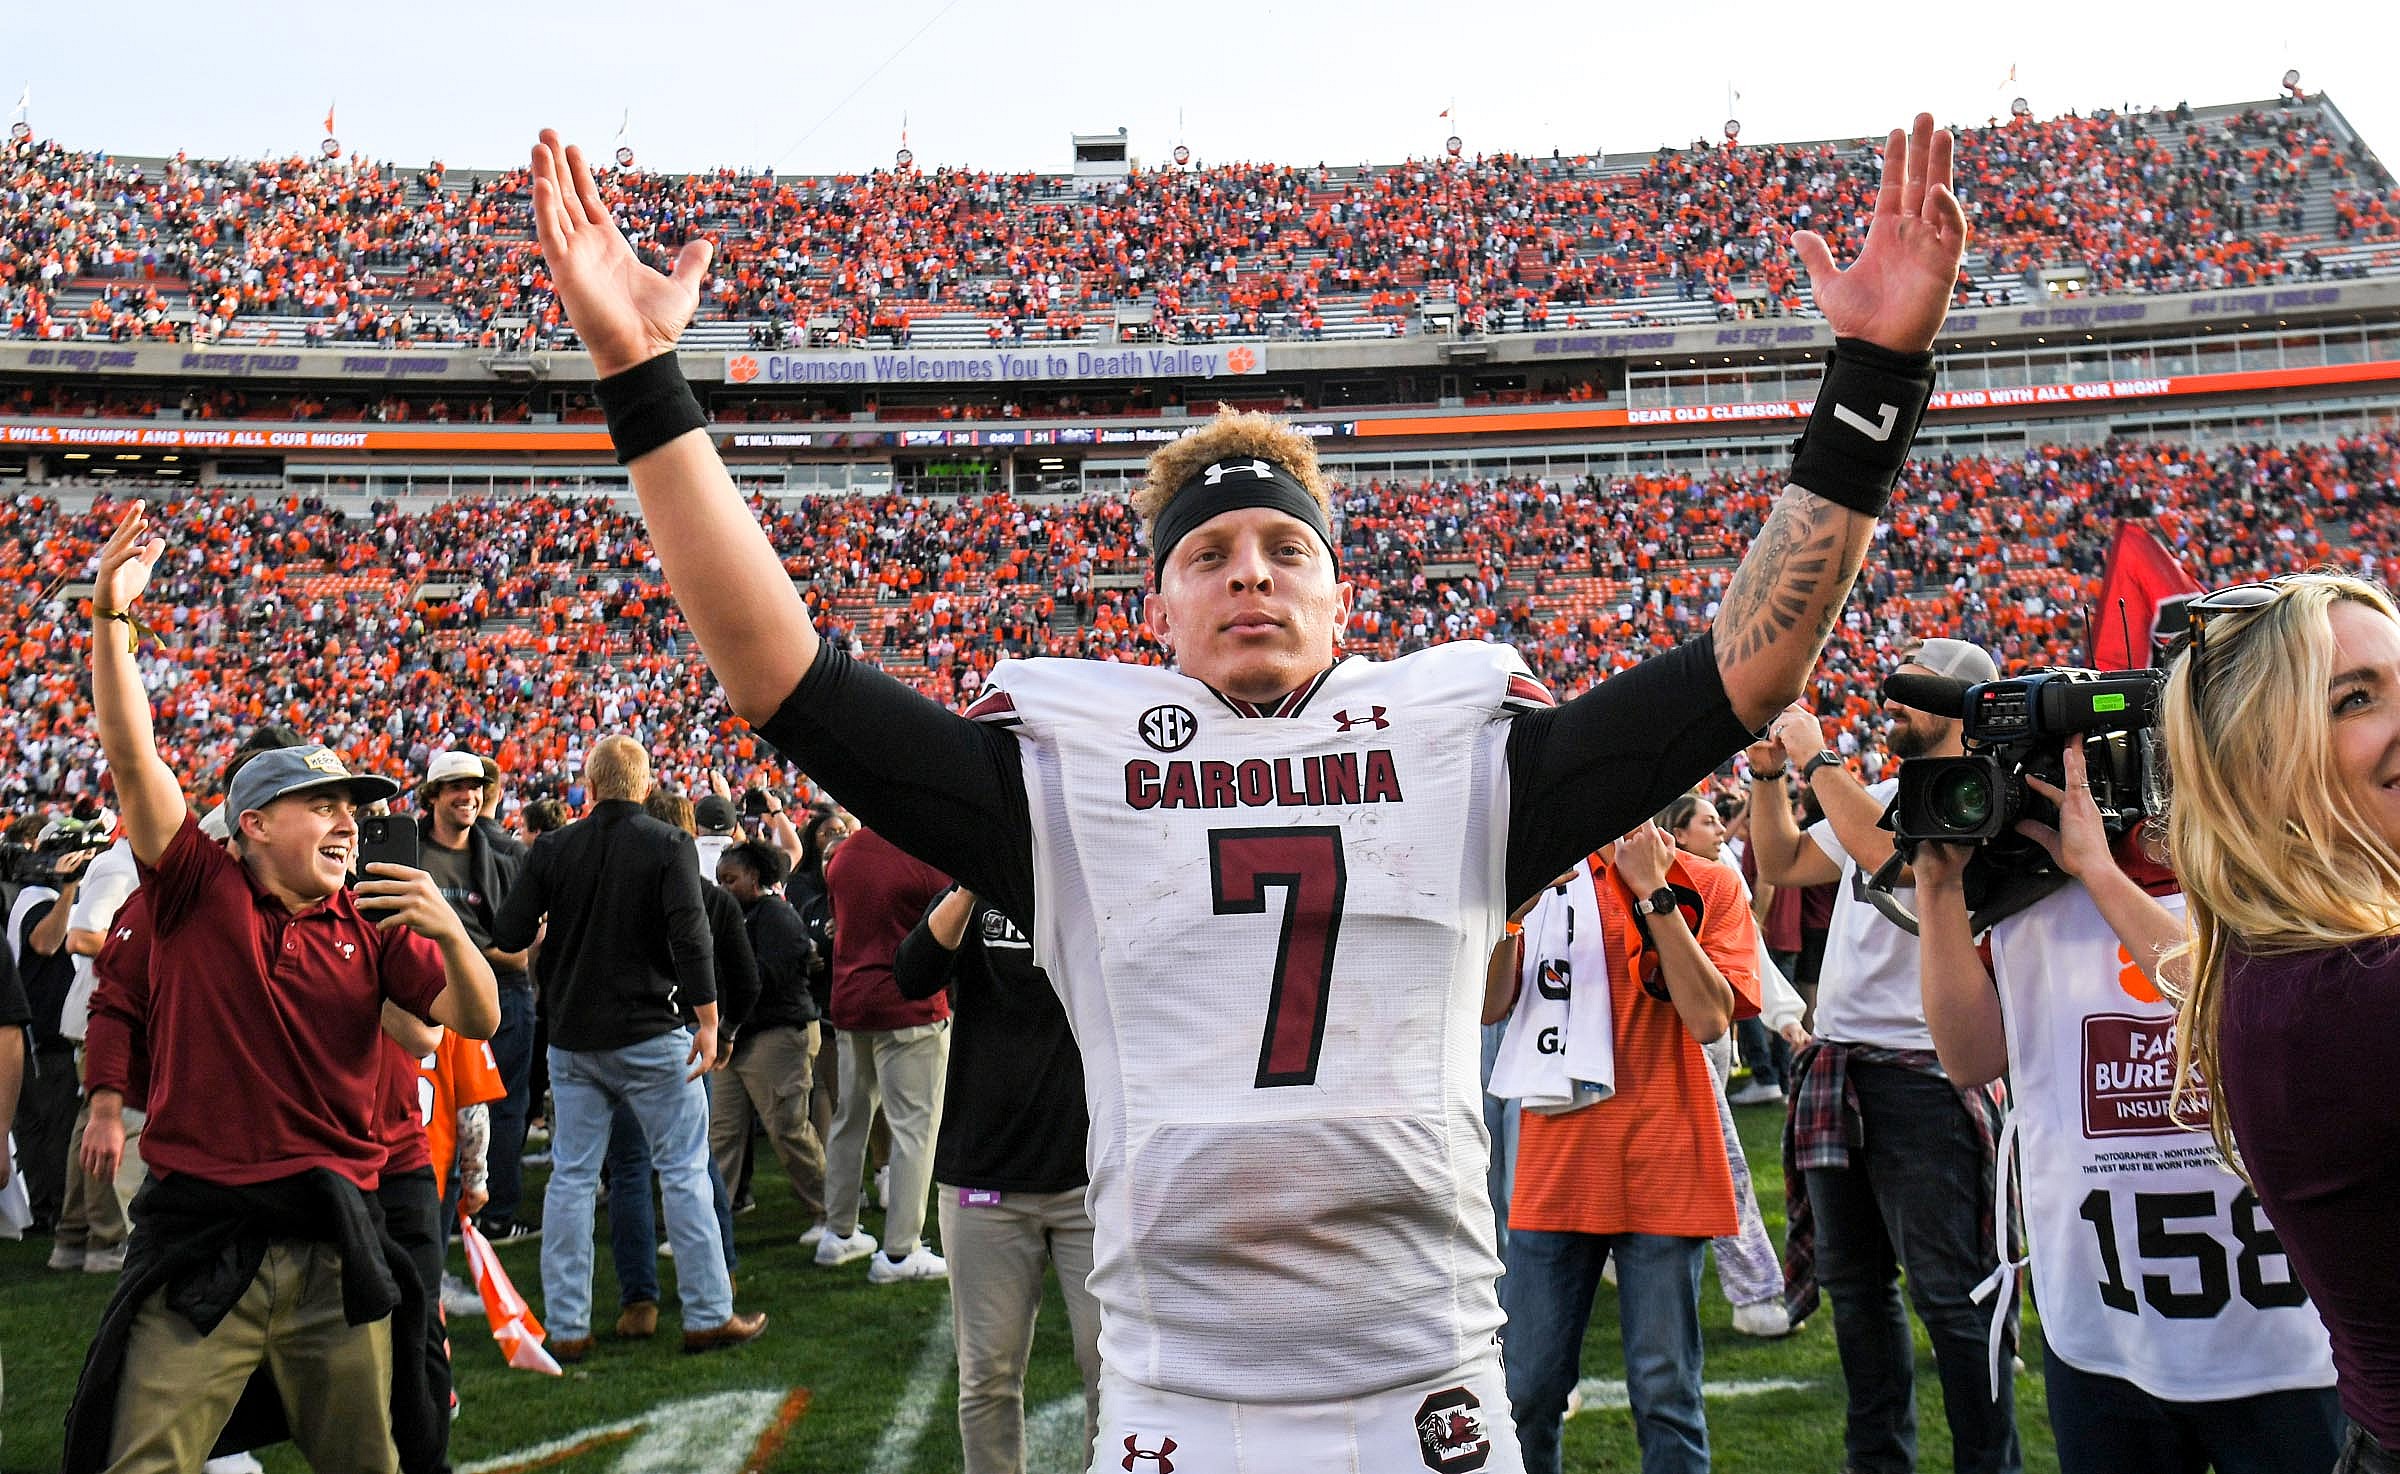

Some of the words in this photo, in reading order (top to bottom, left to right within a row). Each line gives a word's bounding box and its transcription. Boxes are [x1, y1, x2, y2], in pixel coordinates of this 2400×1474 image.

[769, 355, 867, 380] Clemson
[874, 355, 993, 380] Welcomes
[998, 353, 1039, 377] You
[1046, 355, 1069, 376] to
[1077, 351, 1143, 376] Death
[1149, 349, 1219, 379] Valley
[1951, 391, 1985, 406] AND
[1988, 389, 2035, 404] WITH
[2037, 385, 2069, 401] ALL
[2073, 383, 2111, 399] OUR
[1628, 408, 1672, 423] DEAR
[1675, 406, 1709, 422] OLD
[1711, 401, 1796, 420] CLEMSON,
[9, 427, 53, 442] WILL
[57, 428, 139, 443] TRIUMPH
[142, 430, 180, 444] AND
[183, 430, 231, 444] WITH
[232, 432, 267, 446] ALL
[268, 433, 308, 446] OUR
[310, 433, 369, 447] MIGHT
[1034, 432, 1049, 442] 31
[1101, 430, 1135, 442] James
[1144, 707, 1193, 748] SEC
[1125, 750, 1404, 811] CAROLINA
[1208, 825, 1348, 1089] 7
[2130, 1025, 2176, 1060] FAR
[2095, 1057, 2205, 1091] BURE
[2116, 1095, 2210, 1119] INSURAN
[2083, 1165, 2098, 1175] THIS
[2100, 1163, 2117, 1174] VEST
[2118, 1162, 2141, 1172] MUST
[2142, 1161, 2155, 1172] BE
[2156, 1160, 2183, 1171] WORN
[2095, 1150, 2158, 1162] PHOTOGRAPHER
[2080, 1184, 2309, 1319] 158
